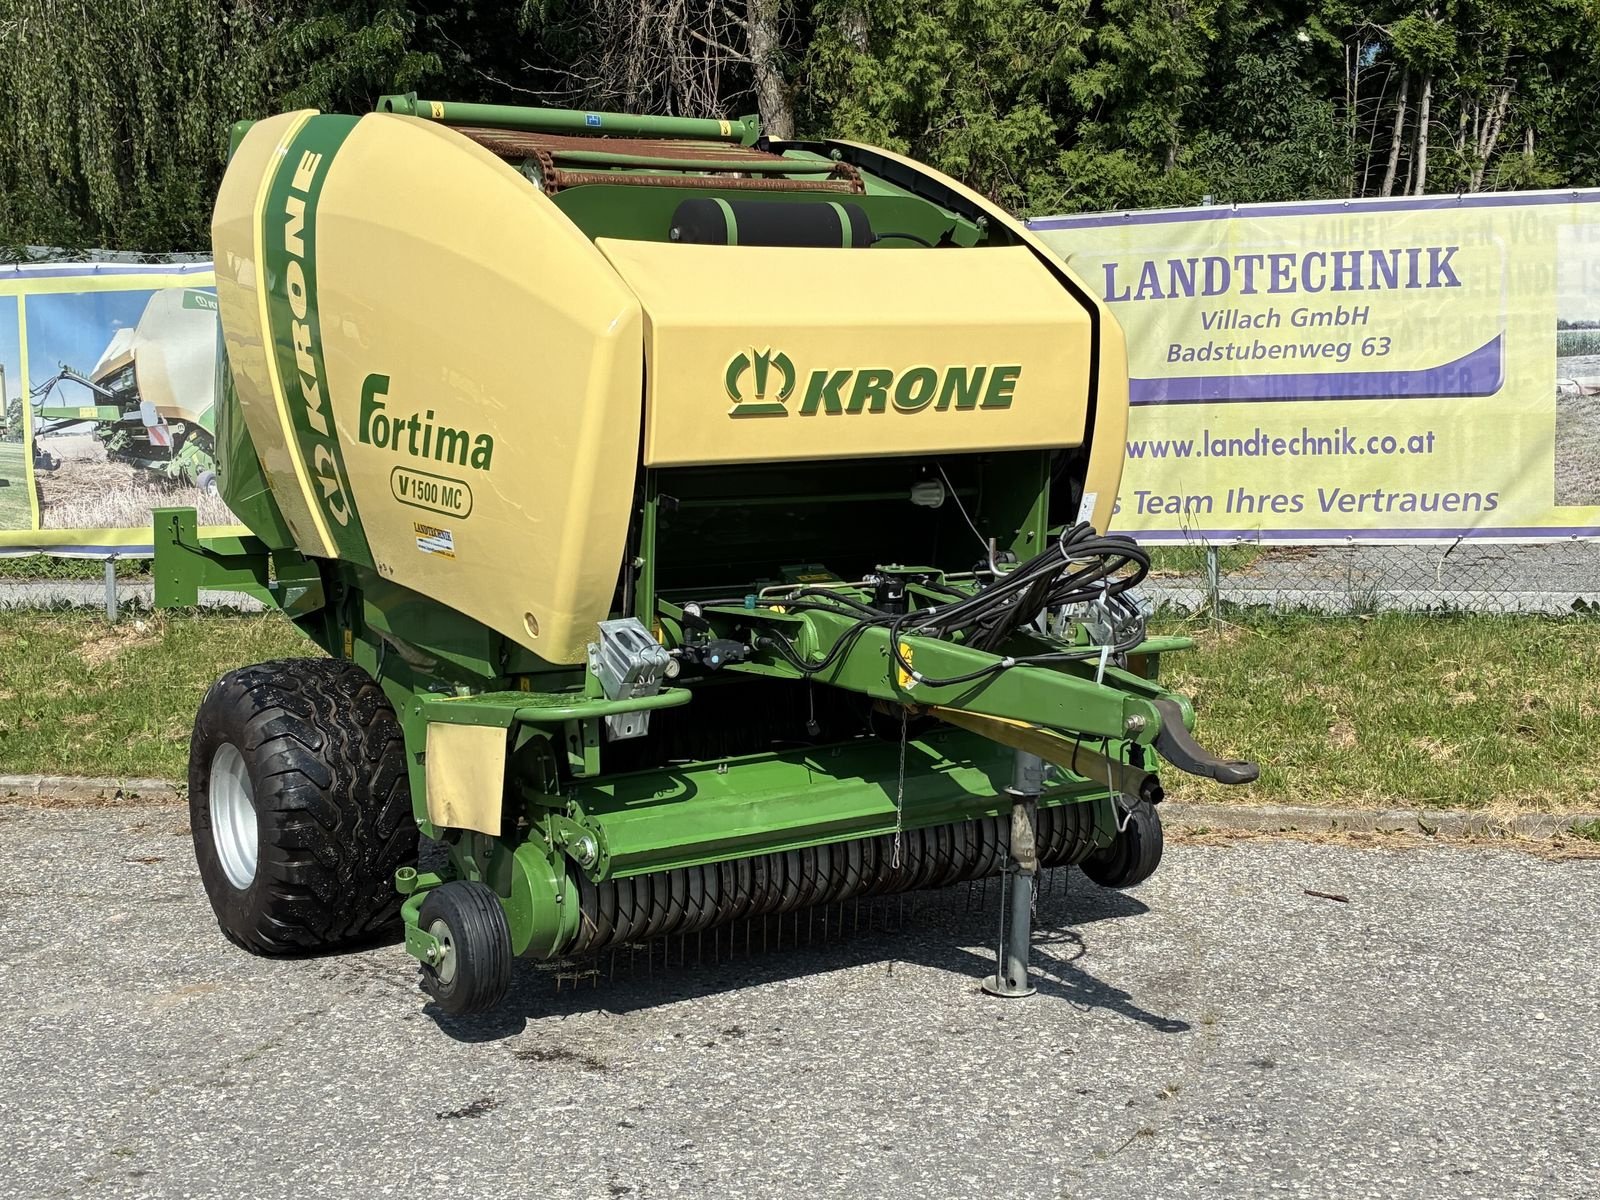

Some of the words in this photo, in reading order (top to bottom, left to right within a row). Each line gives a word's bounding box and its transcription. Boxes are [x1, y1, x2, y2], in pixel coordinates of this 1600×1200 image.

[284, 150, 330, 435] KRONE
[1102, 246, 1462, 303] LANDTECHNIK
[1200, 307, 1281, 331] Villach
[1290, 305, 1370, 328] GmbH
[1166, 338, 1353, 364] Badstubenweg
[1360, 336, 1393, 357] 63
[799, 365, 1023, 415] KRONE
[358, 372, 495, 471] Fortima
[1126, 426, 1436, 459] www.landtechnik.co.at
[398, 474, 410, 496] V
[411, 478, 438, 504] 1500
[441, 485, 463, 511] MC
[1134, 490, 1214, 515] Team
[1226, 487, 1304, 514] Ihres
[1317, 487, 1499, 514] Vertrauens
